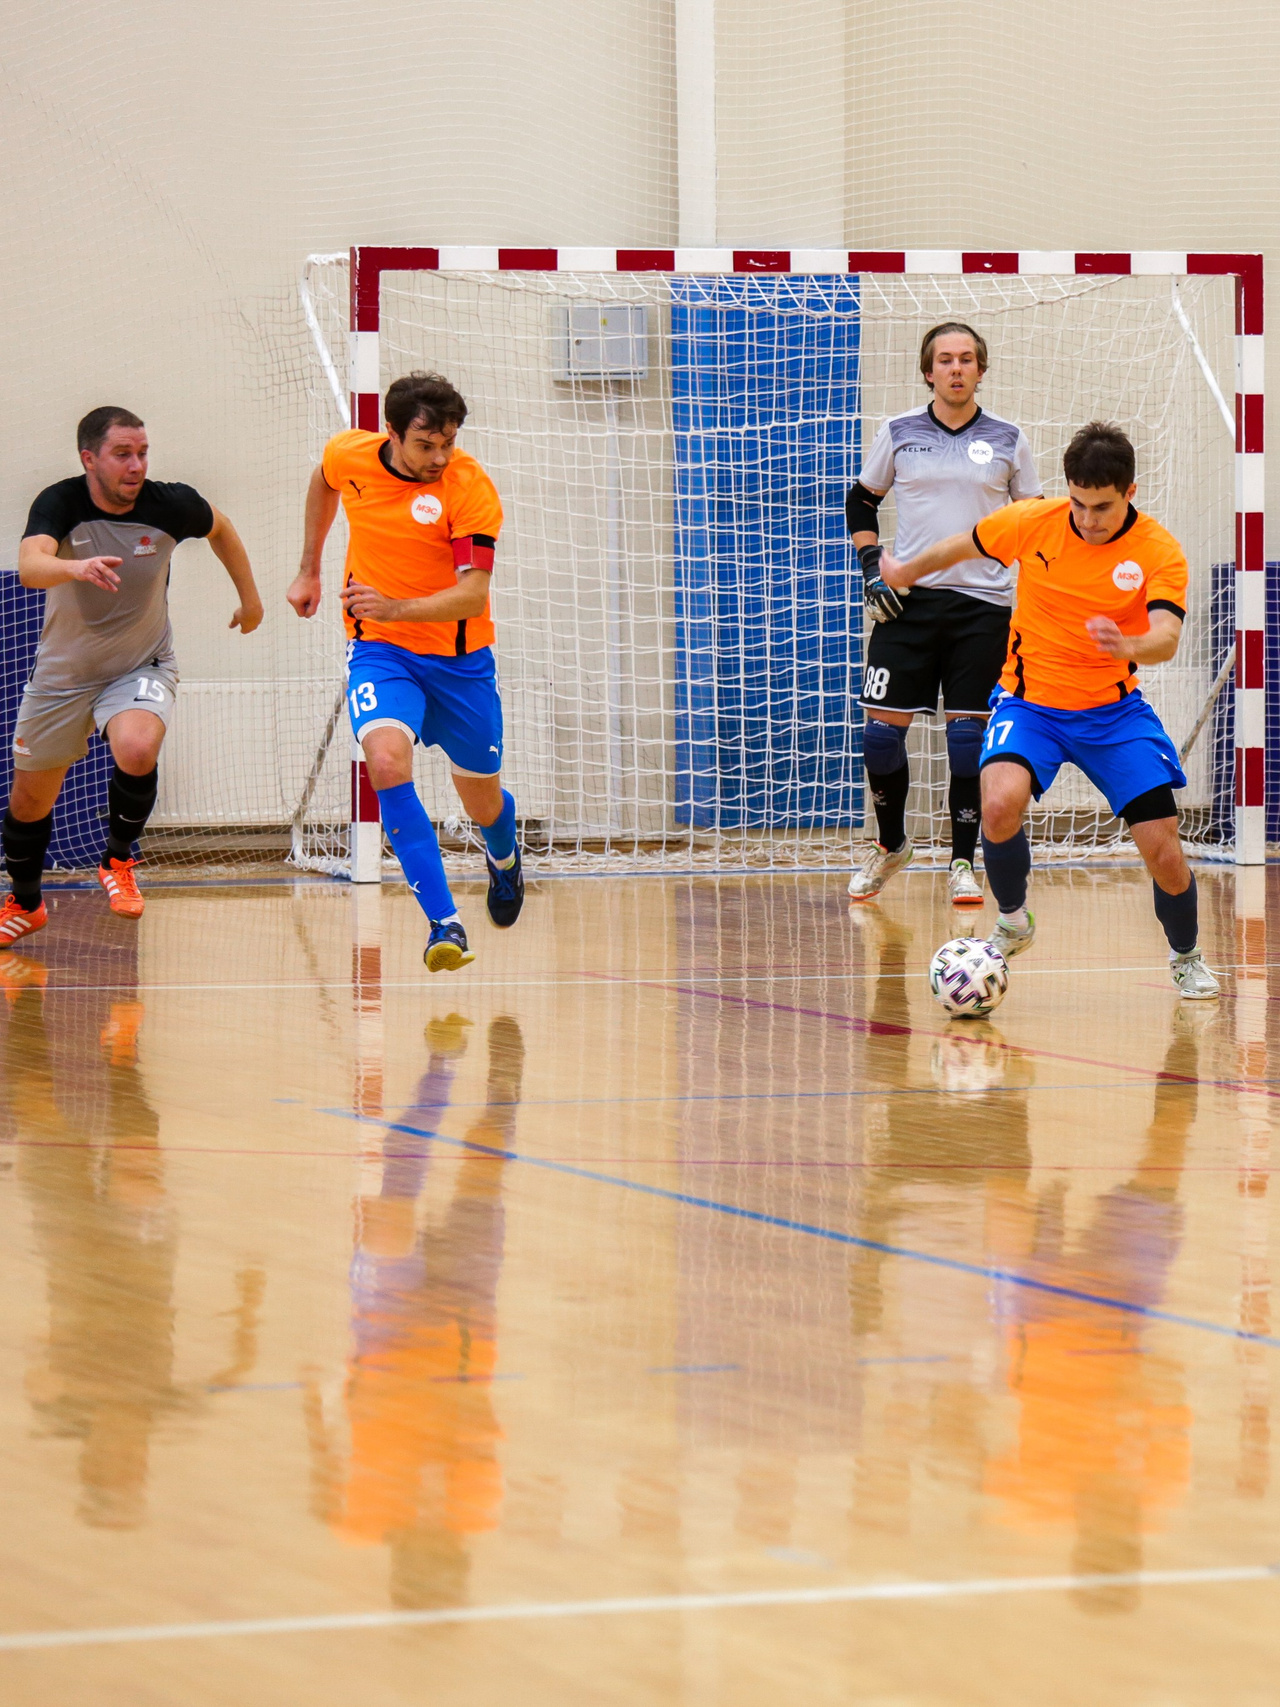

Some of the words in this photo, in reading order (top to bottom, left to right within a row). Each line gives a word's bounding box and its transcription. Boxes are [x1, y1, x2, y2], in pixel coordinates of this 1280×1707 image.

[972, 448, 990, 456] МЭС
[416, 504, 438, 515] МЭС
[1117, 572, 1139, 581] МЭС
[137, 677, 166, 702] 15
[863, 666, 890, 700] 88
[350, 681, 378, 719] 13
[987, 720, 1014, 750] 17
